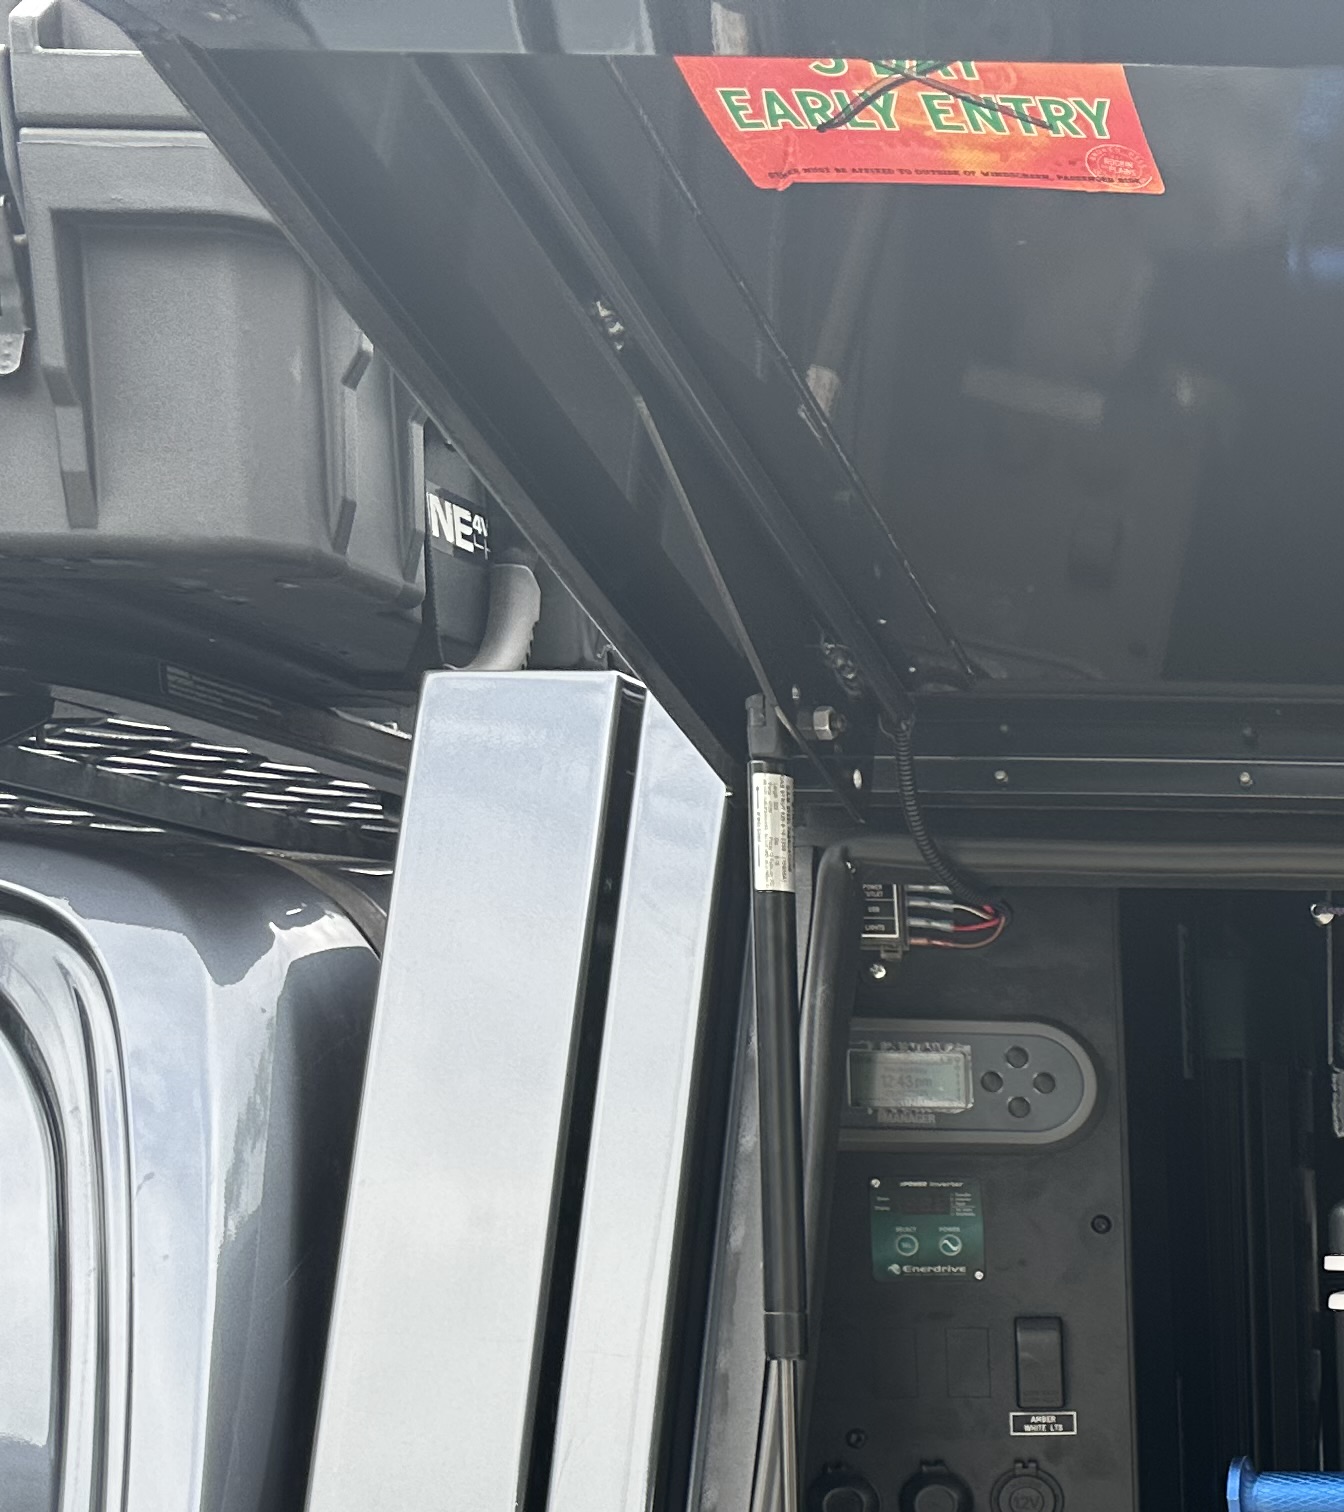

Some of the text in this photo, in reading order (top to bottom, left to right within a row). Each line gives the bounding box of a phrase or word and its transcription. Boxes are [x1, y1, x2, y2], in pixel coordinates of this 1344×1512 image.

[715, 87, 1111, 139] EARLY ENTRY
[902, 1265, 966, 1273] Enerdrive
